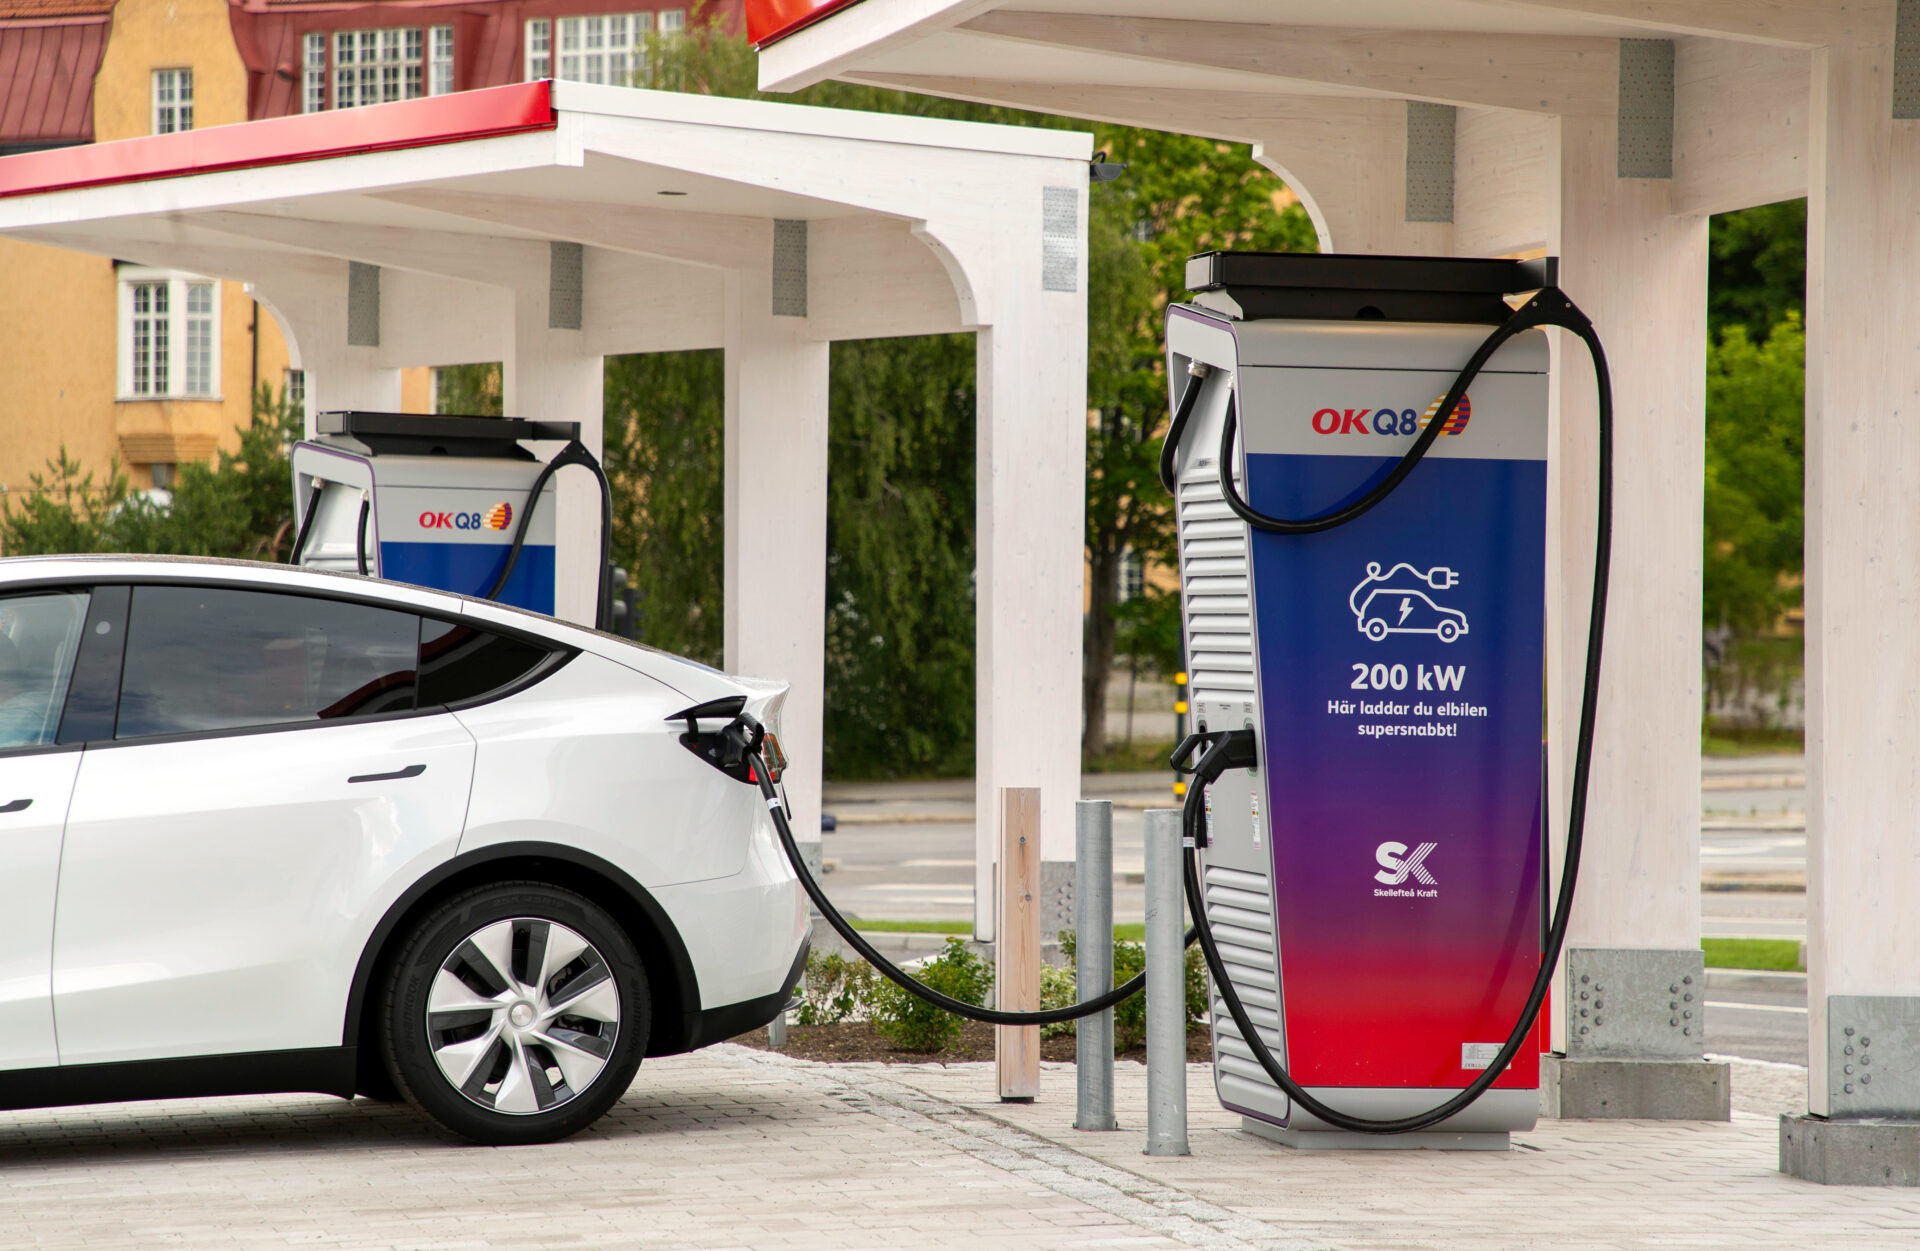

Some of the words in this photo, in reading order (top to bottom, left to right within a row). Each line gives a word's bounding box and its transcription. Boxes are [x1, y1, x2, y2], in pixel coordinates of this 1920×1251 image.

[1311, 407, 1417, 436] OKQ8
[418, 510, 482, 530] OKQ8
[1350, 662, 1409, 691] 200
[1417, 662, 1466, 692] kW
[1327, 699, 1357, 715] Här
[1360, 700, 1410, 716] laddar
[1413, 701, 1433, 716] du
[1436, 701, 1488, 717] elbilen
[1357, 721, 1457, 739] supersnabbt!
[1374, 841, 1438, 885] SK
[1373, 888, 1415, 898] Skellefteå
[1416, 889, 1438, 898] Kraft
